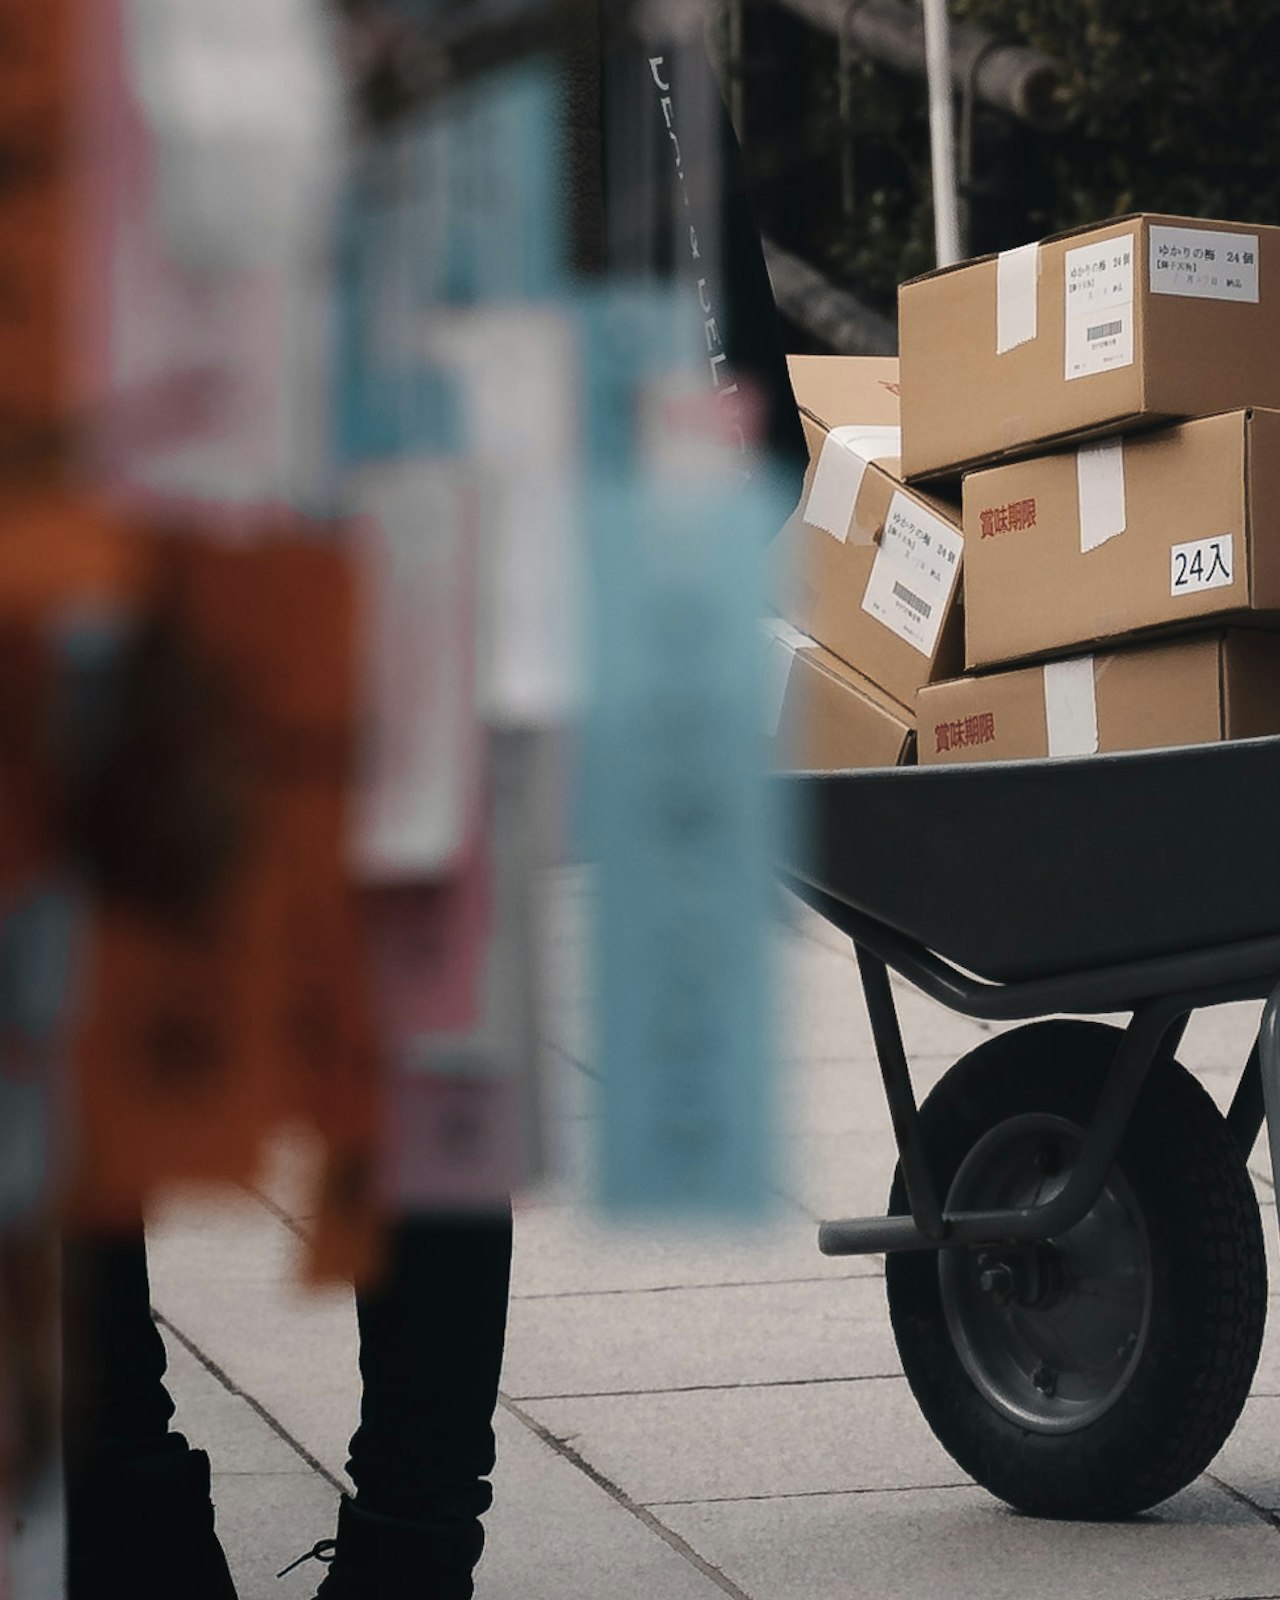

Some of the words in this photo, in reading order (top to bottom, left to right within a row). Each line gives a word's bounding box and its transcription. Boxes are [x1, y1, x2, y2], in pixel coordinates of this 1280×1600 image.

[1158, 244, 1216, 261] ゆかりの梅
[980, 498, 1037, 540] 賞味期限
[1174, 543, 1231, 587] 24入
[934, 712, 996, 753] 賞味期限
